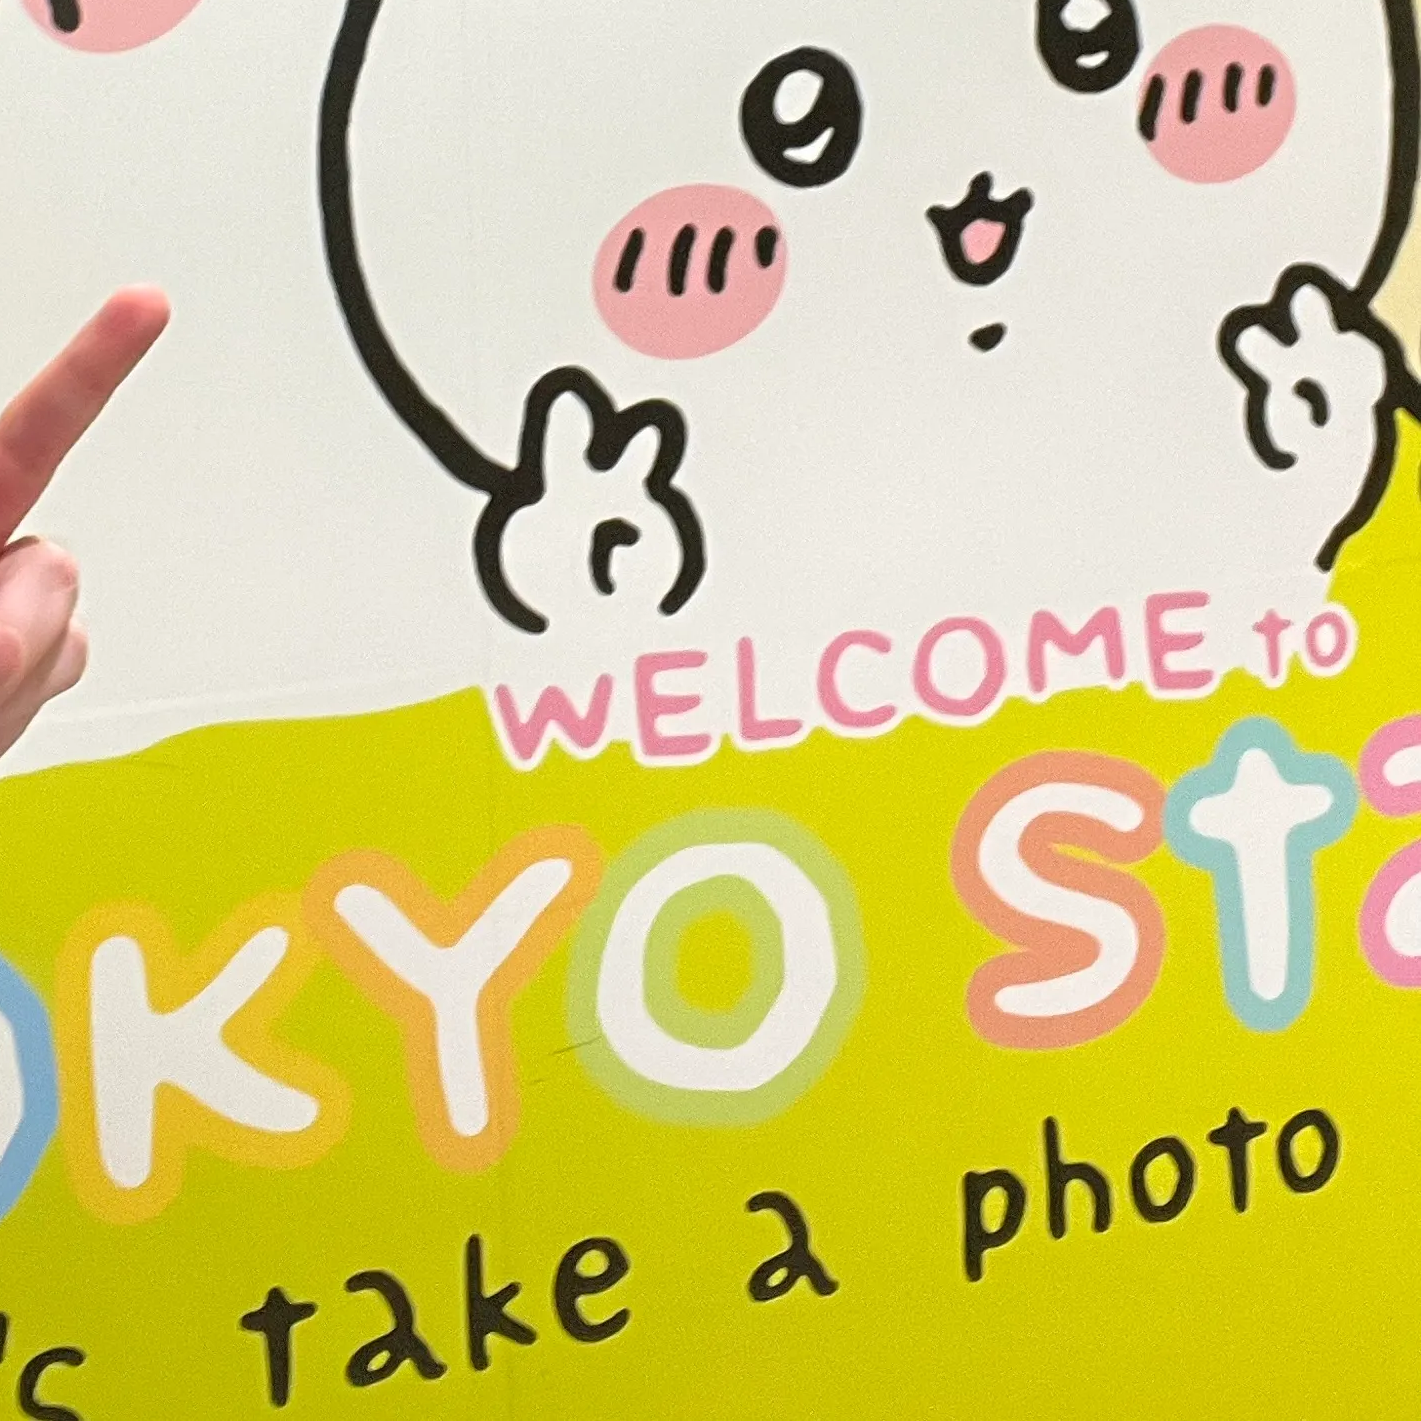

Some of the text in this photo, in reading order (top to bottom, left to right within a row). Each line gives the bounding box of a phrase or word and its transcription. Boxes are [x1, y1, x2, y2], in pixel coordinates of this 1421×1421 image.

[495, 590, 1349, 761] WELCOME to
[951, 715, 1421, 1049] St
[239, 1233, 630, 1409] take
[746, 1190, 839, 1303] a
[962, 1106, 1340, 1283] photo
